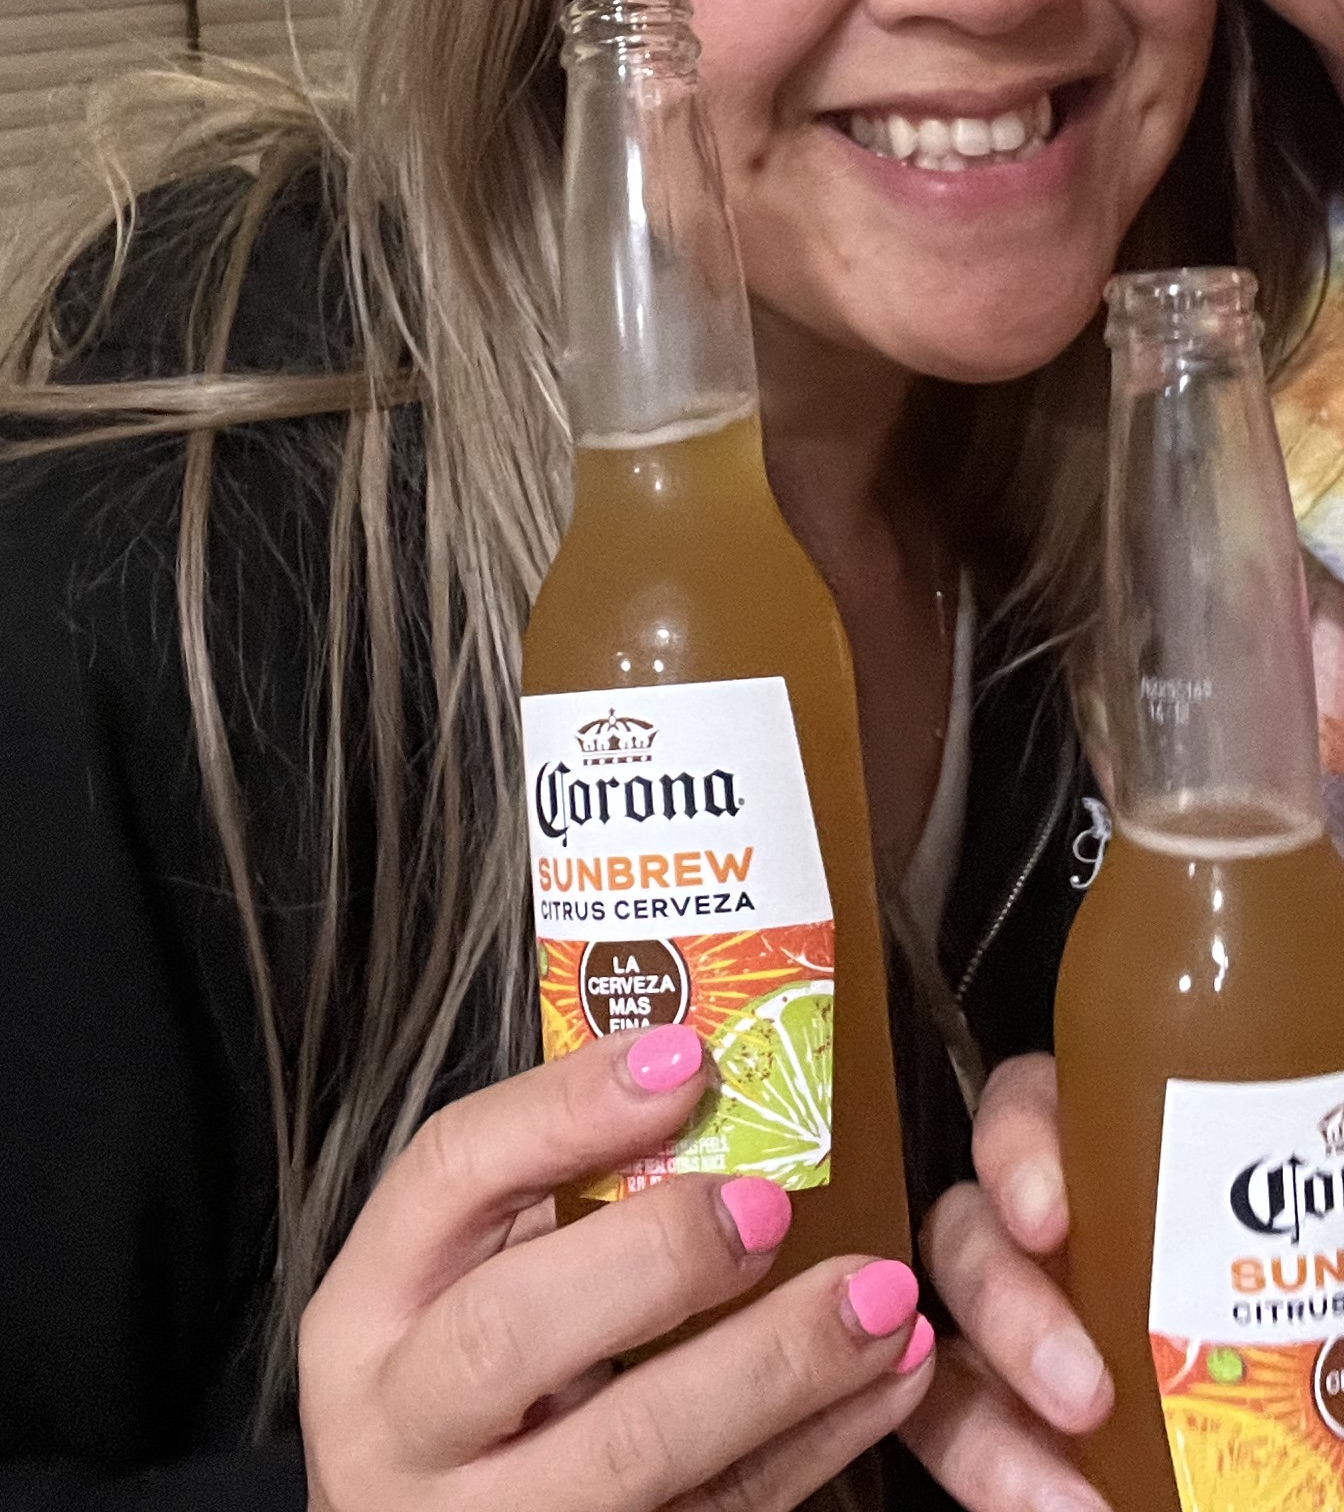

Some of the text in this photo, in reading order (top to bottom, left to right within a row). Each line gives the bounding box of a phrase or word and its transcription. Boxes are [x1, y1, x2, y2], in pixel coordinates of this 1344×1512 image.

[536, 761, 740, 847] Corona
[538, 846, 754, 892] SUNBREW
[541, 891, 755, 921] CITRUS CERVEZA
[612, 955, 640, 974] LA
[587, 974, 676, 995] CERVEZA
[609, 996, 652, 1015] MAS
